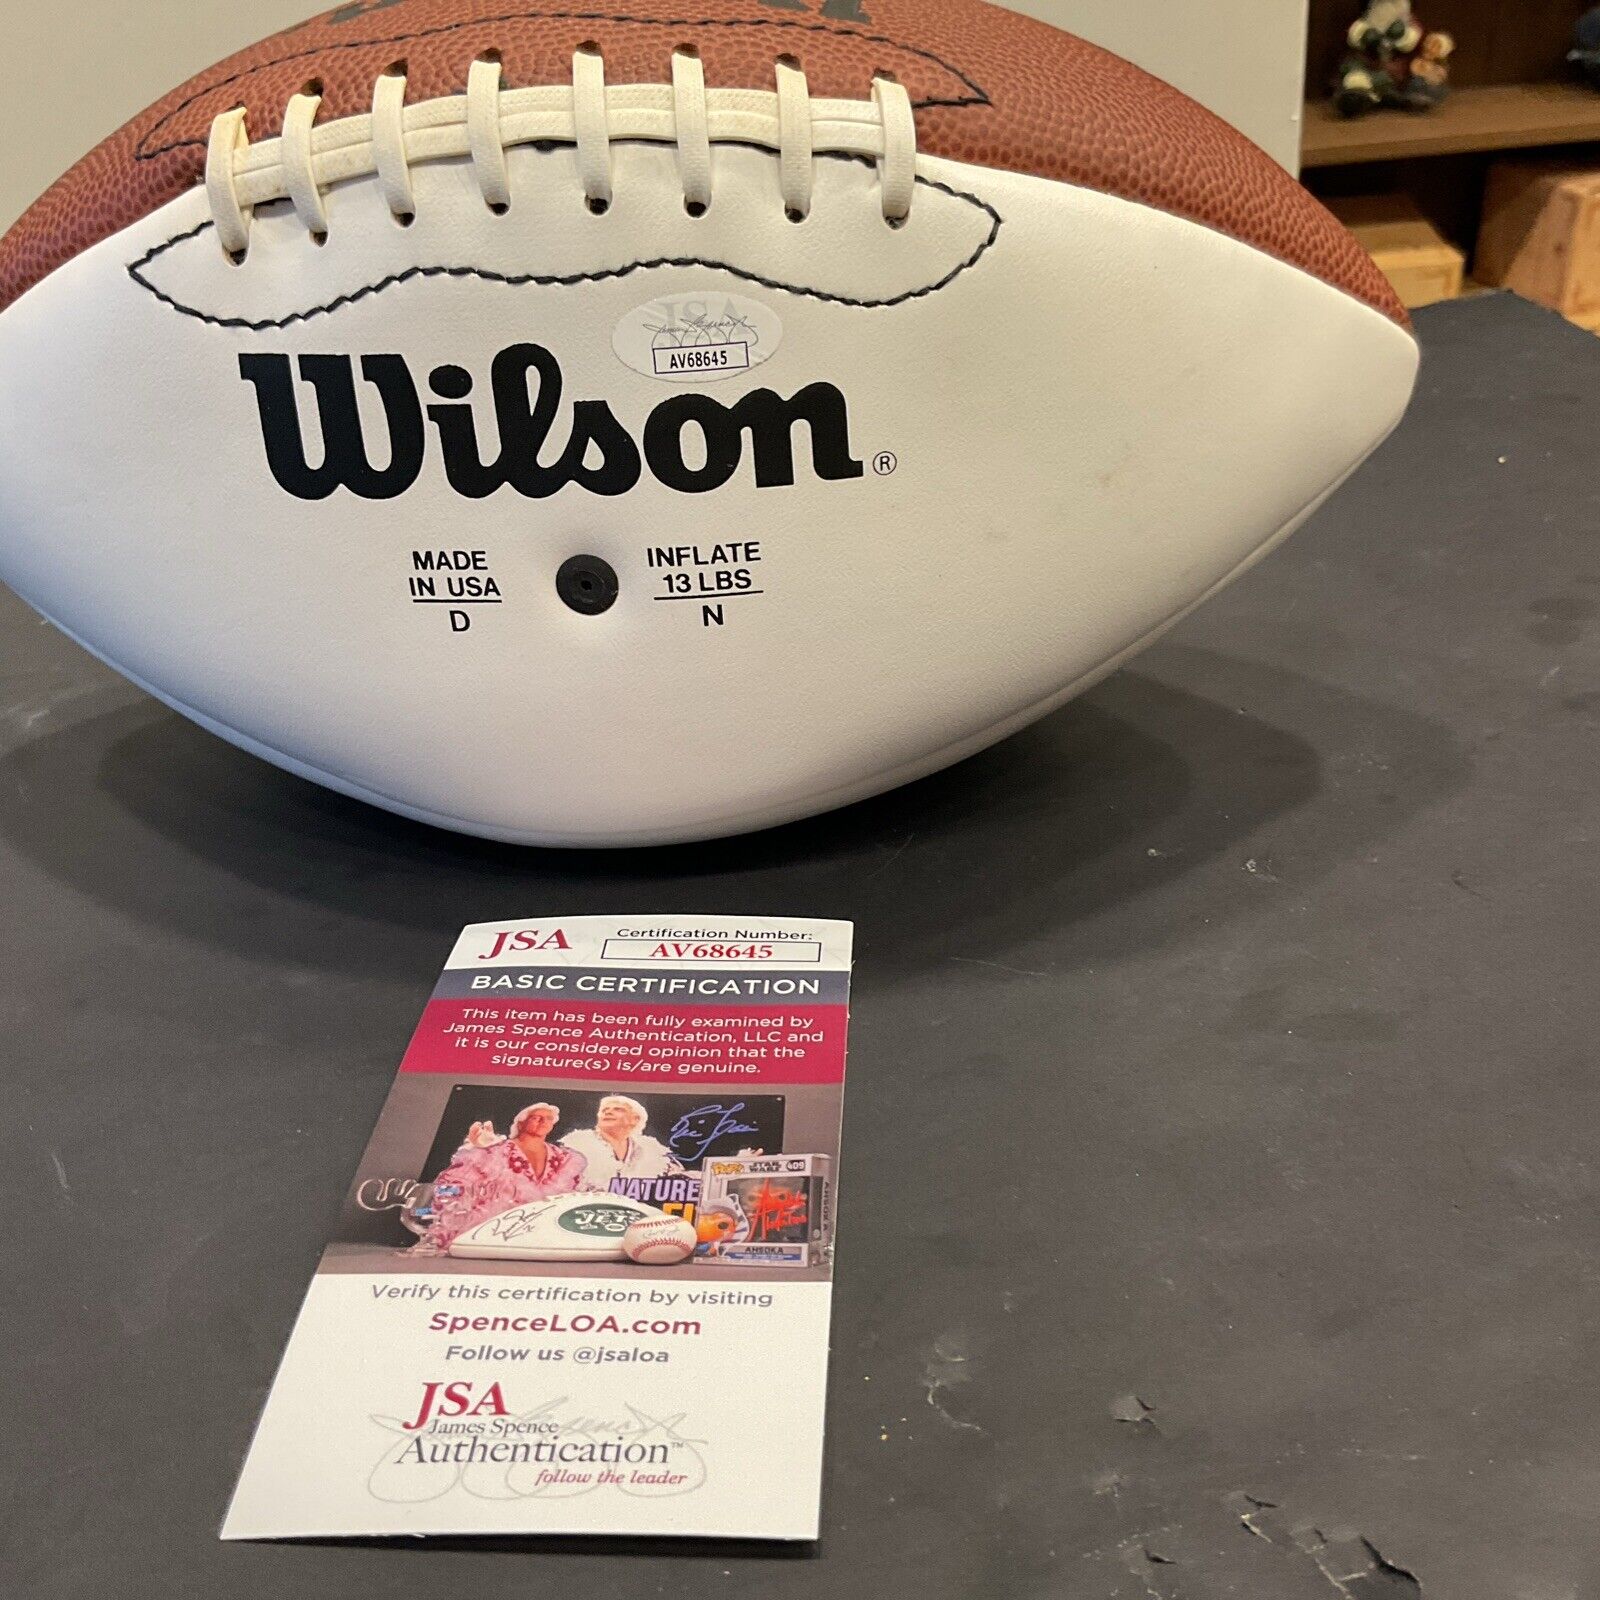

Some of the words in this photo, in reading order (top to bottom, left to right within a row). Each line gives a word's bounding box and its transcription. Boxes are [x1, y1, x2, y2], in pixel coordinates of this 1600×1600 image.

[669, 350, 728, 369] AV68645
[238, 343, 864, 500] Wilson
[412, 550, 489, 571] MADE
[647, 541, 762, 568] INFLATE
[408, 577, 436, 597] IN
[446, 576, 502, 597] USA
[662, 572, 692, 593] 13
[699, 568, 752, 592] LBS
[449, 609, 471, 632] D
[702, 604, 724, 627] N
[478, 928, 573, 960] JSA
[617, 928, 729, 939] Certification
[735, 929, 813, 940] Number:
[649, 942, 773, 959] AV68645
[471, 974, 567, 990] BASIC
[576, 976, 820, 995] CERTIFICATION
[462, 1008, 500, 1019] This
[504, 1009, 548, 1021] item
[552, 1010, 586, 1023] has
[592, 1012, 639, 1025] been
[645, 1014, 686, 1029] fully
[691, 1016, 784, 1028] examined
[790, 1016, 814, 1029] by
[443, 1022, 506, 1034] James
[511, 1024, 583, 1037] Spence
[588, 1027, 737, 1044] Authentication,
[744, 1031, 781, 1043] LLC
[787, 1031, 824, 1043] and
[455, 1036, 469, 1048] it
[474, 1037, 490, 1049] is
[495, 1040, 530, 1050] our
[534, 1042, 643, 1056] considered
[648, 1046, 721, 1059] opinion
[728, 1046, 767, 1058] that
[774, 1047, 806, 1058] the
[491, 1053, 611, 1071] signature(s)
[616, 1059, 671, 1073] is/are
[677, 1062, 761, 1075] genuine.
[744, 1246, 784, 1255] AHSOKA
[371, 1284, 441, 1301] Verify
[448, 1284, 491, 1300] this
[497, 1286, 642, 1303] certification
[649, 1289, 680, 1305] by
[687, 1290, 774, 1308] visiting
[428, 1312, 701, 1335] SpenceLOA.com
[445, 1345, 531, 1361] Follow
[538, 1349, 565, 1361] us
[572, 1346, 670, 1365] @jsaloa
[402, 1381, 511, 1430] JSA
[428, 1418, 486, 1435] James
[490, 1419, 559, 1436] Spence
[534, 1469, 592, 1486] follow
[597, 1469, 625, 1484] the
[630, 1470, 689, 1486] leader
